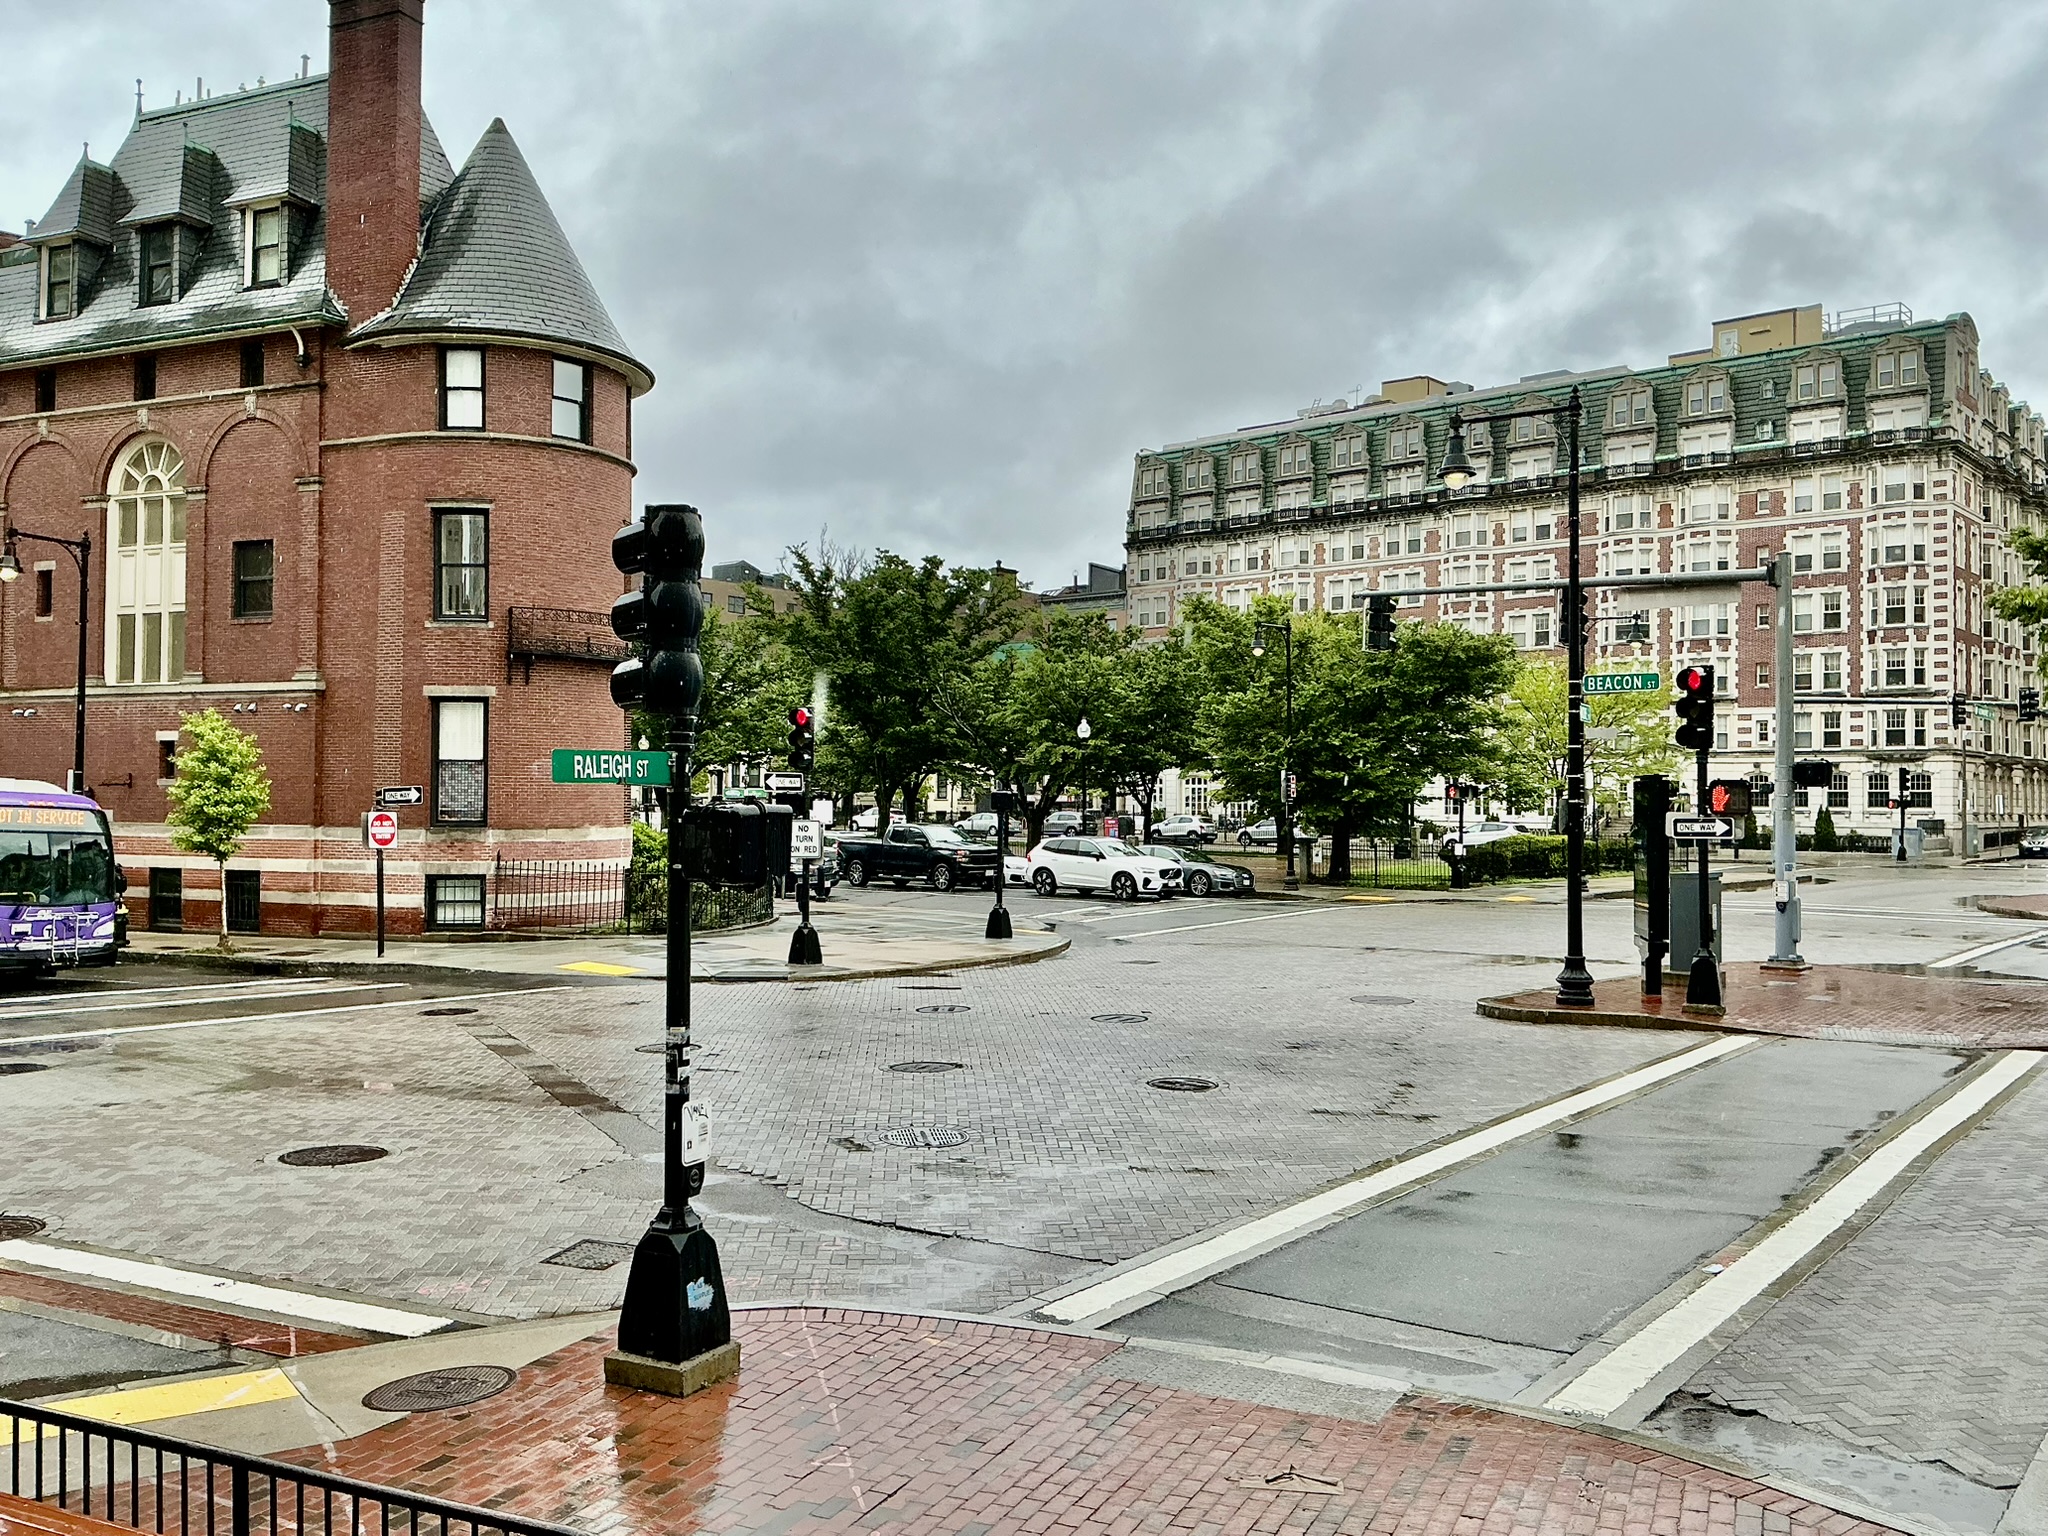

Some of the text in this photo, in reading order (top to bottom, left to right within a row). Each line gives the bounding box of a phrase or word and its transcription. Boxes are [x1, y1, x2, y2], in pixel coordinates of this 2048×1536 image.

[1588, 676, 1655, 690] BEACON ST
[574, 755, 649, 778] RALEIGH ST
[17, 809, 32, 824] IN
[35, 809, 85, 826] SERVICE
[1680, 824, 1695, 832] ONE
[795, 835, 813, 843] TURN
